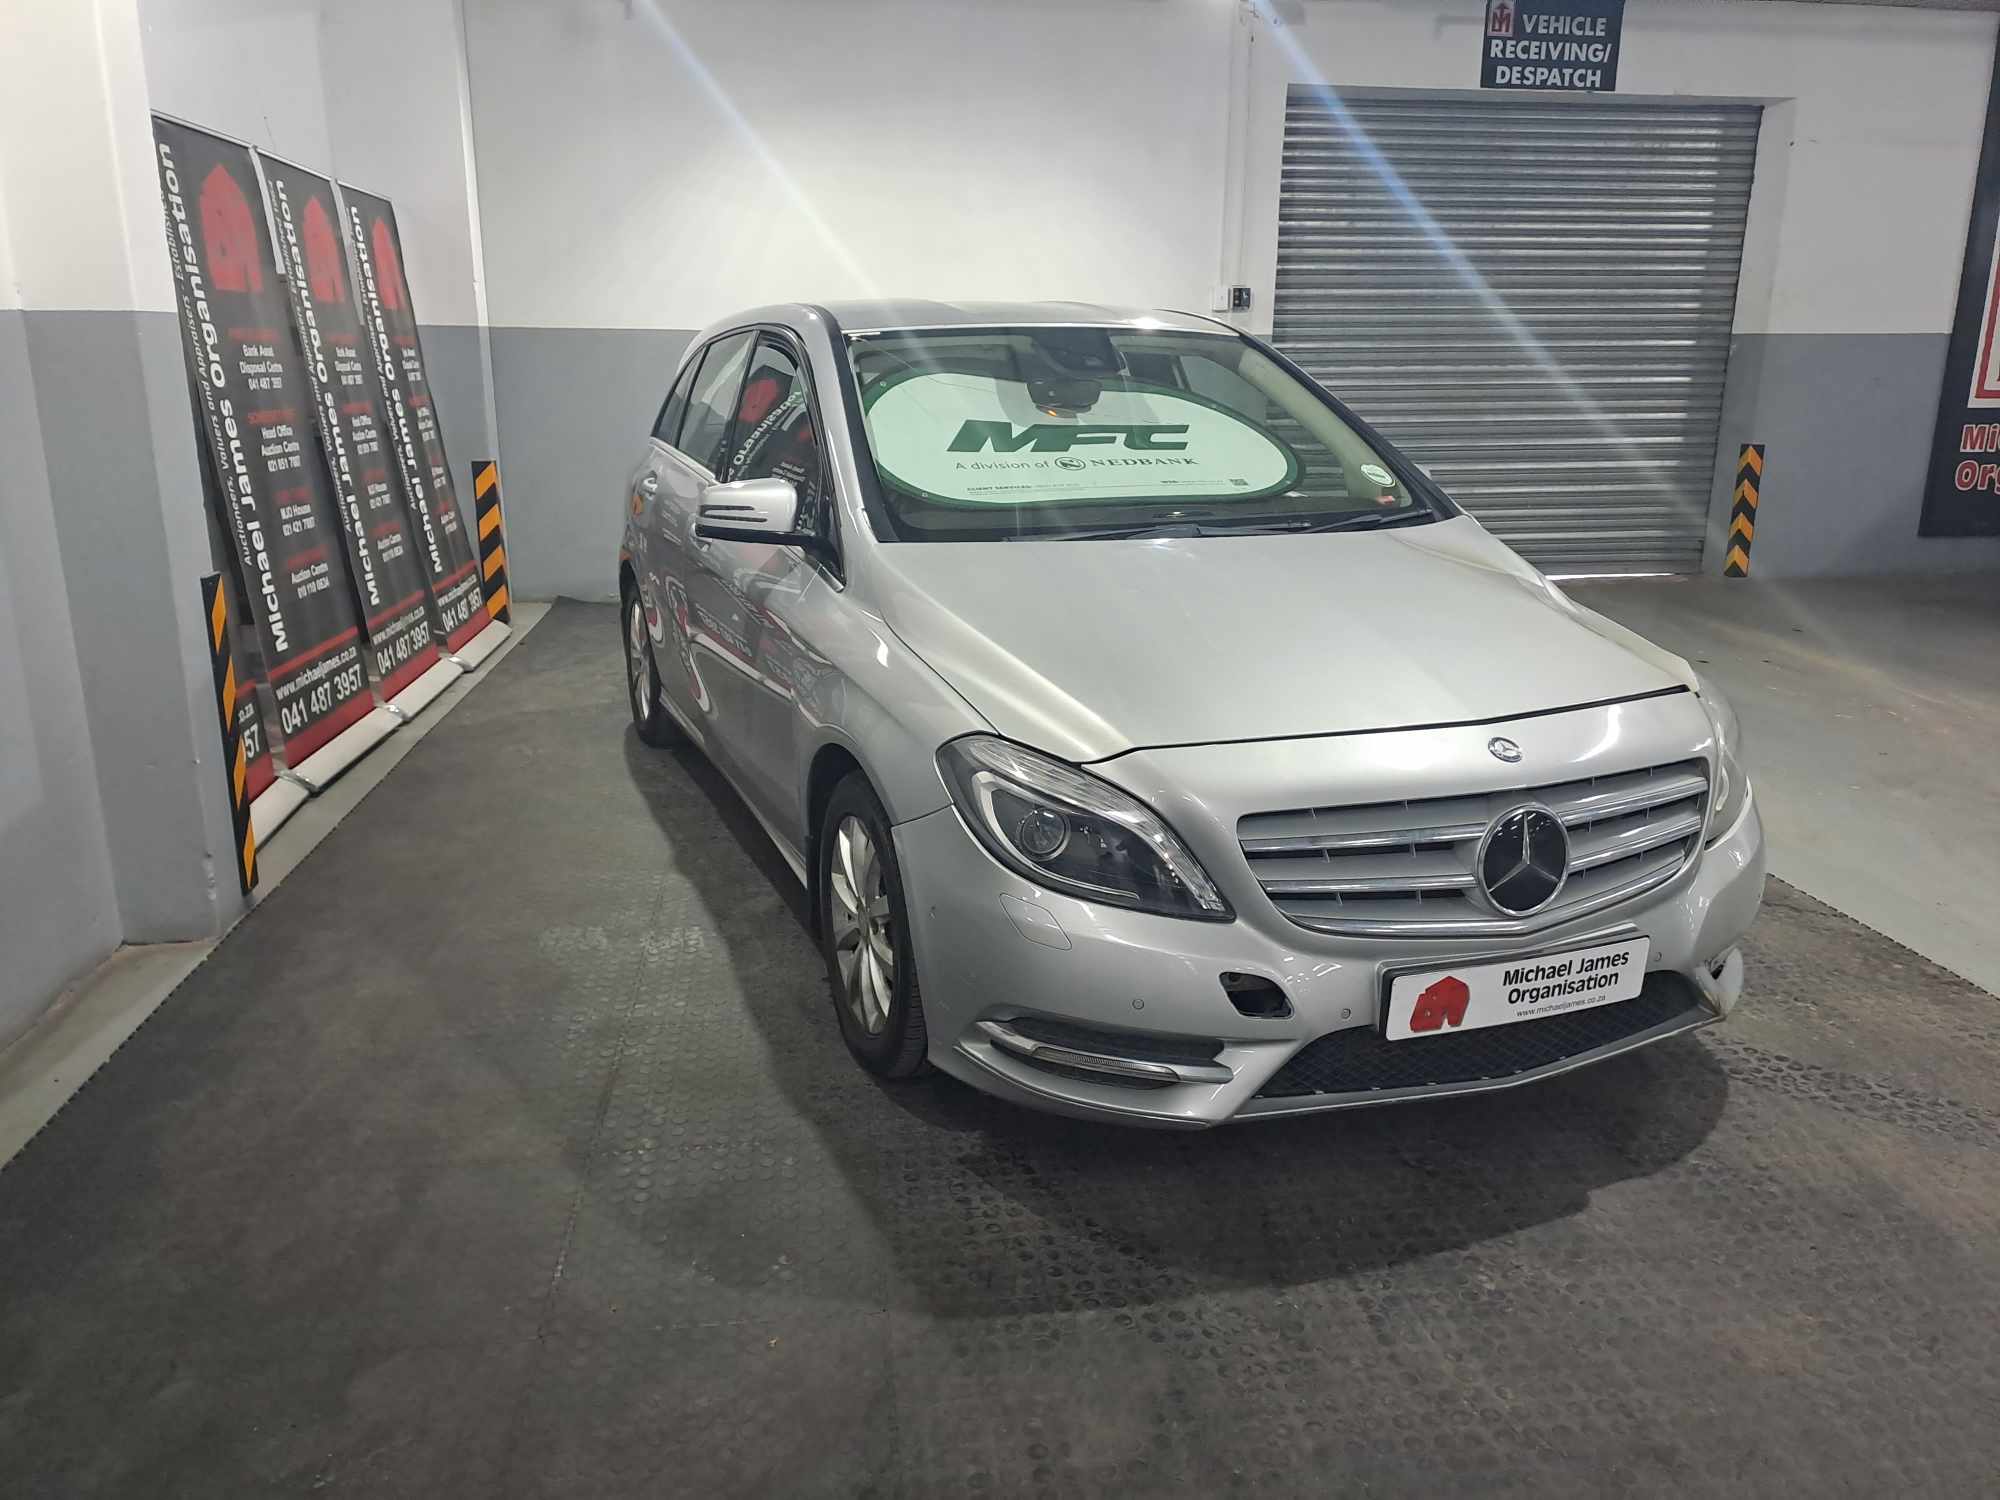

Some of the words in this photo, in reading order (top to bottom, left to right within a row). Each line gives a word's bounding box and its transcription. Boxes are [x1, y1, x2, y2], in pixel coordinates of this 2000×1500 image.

[1490, 39, 1612, 63] RECEIVING/
[1522, 14, 1607, 36] VEHICLE
[1495, 66, 1601, 87] DESPATCH
[159, 143, 225, 388] Organisation
[276, 180, 328, 383] Organisation
[351, 206, 395, 380] Organisation
[183, 295, 207, 378] Appraisers
[201, 380, 214, 411] and
[211, 415, 229, 470] Valuers
[220, 399, 256, 511] James
[324, 391, 352, 487] James
[392, 388, 417, 470] James
[946, 420, 1190, 452] MFC
[956, 462, 967, 470] A
[971, 460, 1031, 470] division
[1034, 460, 1050, 469] of
[1089, 457, 1200, 467] NEDBANK
[346, 494, 380, 606] Michael
[411, 477, 443, 573] Michael
[246, 520, 289, 652] Michael
[376, 644, 396, 675] 041
[396, 634, 412, 662] 487
[410, 620, 431, 650] 3957
[442, 607, 458, 632] 041
[281, 697, 308, 734] 041
[310, 681, 332, 715] 487
[334, 663, 362, 700] 3957
[1502, 959, 1573, 986] Michael
[1575, 951, 1630, 975] James
[1507, 972, 1619, 1005] Organisation
